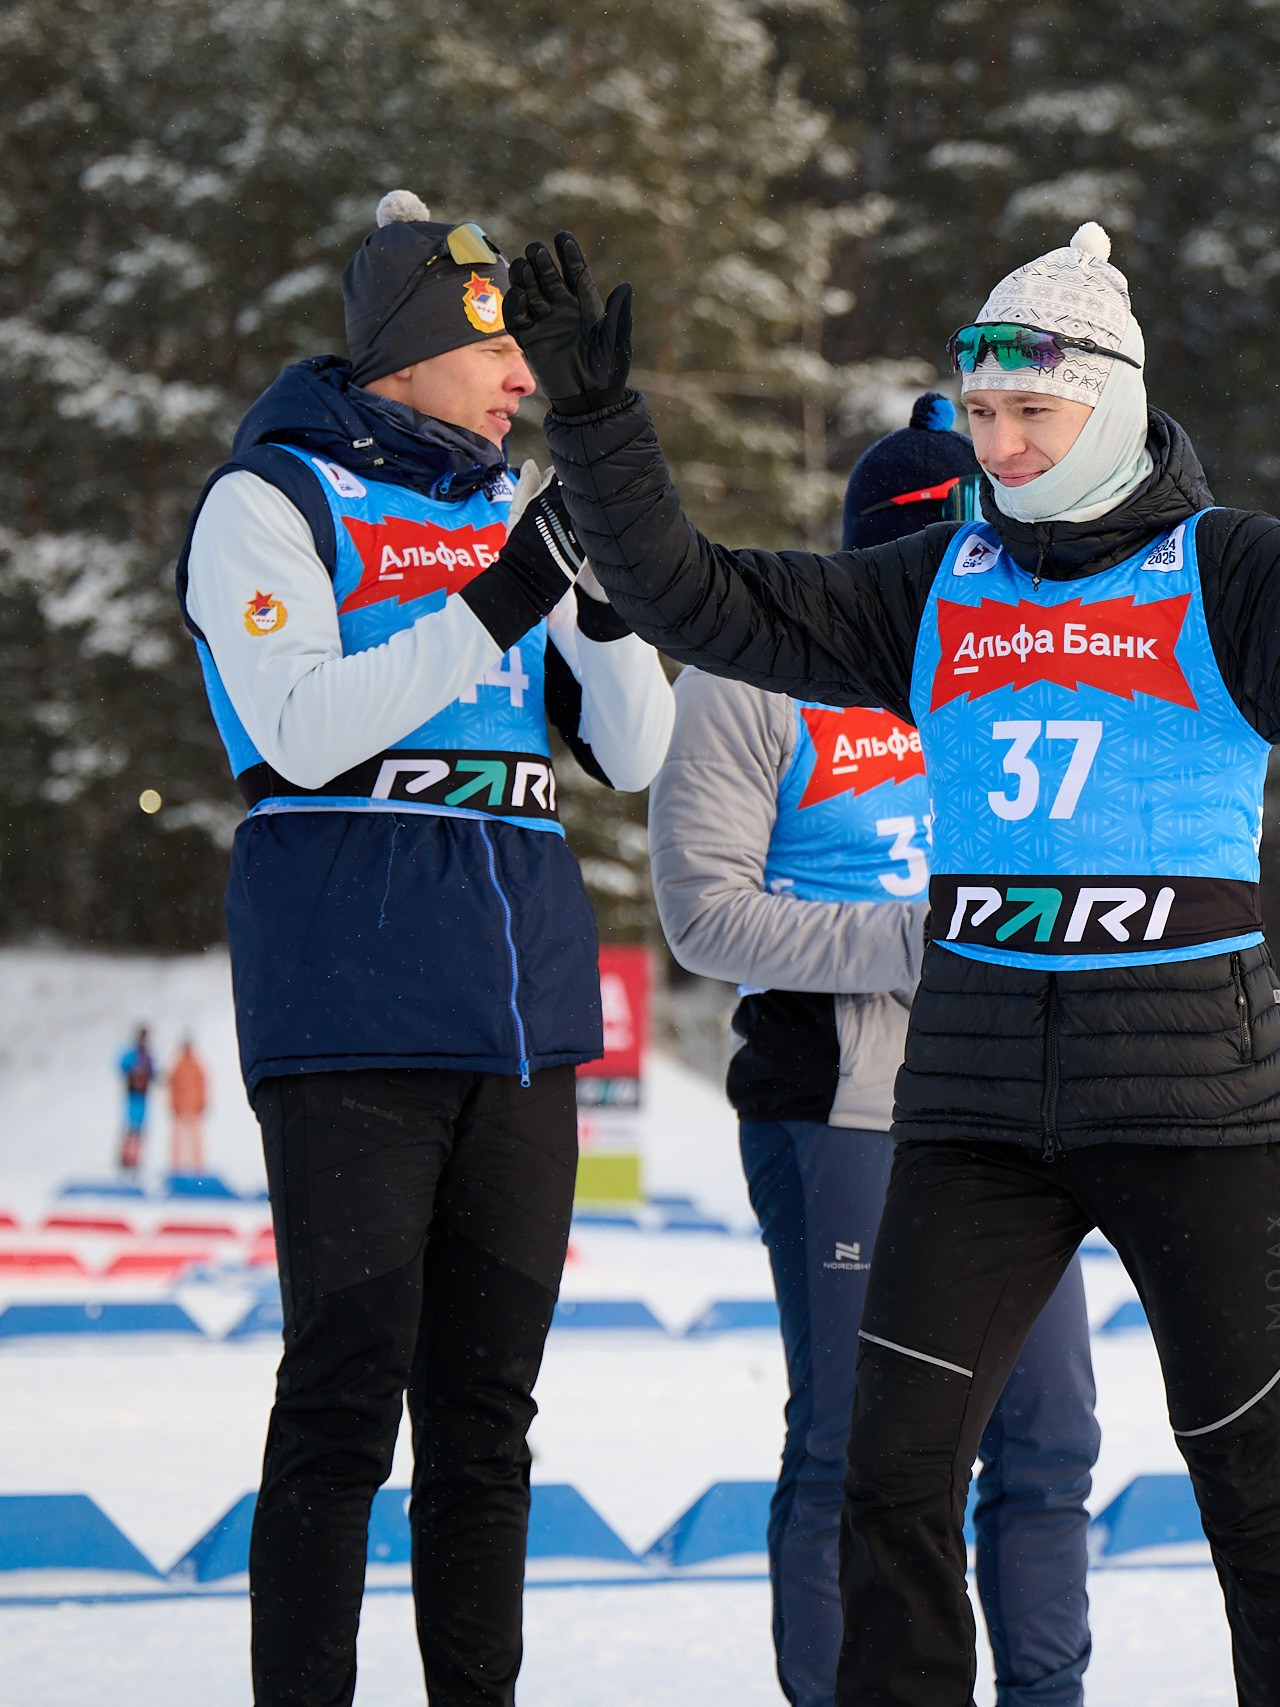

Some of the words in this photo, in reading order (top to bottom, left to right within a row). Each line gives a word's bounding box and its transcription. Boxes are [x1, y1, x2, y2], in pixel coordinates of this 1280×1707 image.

[380, 541, 475, 574] Альфа
[1148, 551, 1176, 565] 2025
[953, 623, 1055, 663] Альфа
[1063, 622, 1159, 660] Банк
[459, 646, 529, 708] 4
[832, 727, 923, 762] Альфа
[987, 720, 1103, 821] 37
[946, 886, 1175, 943] PARI
